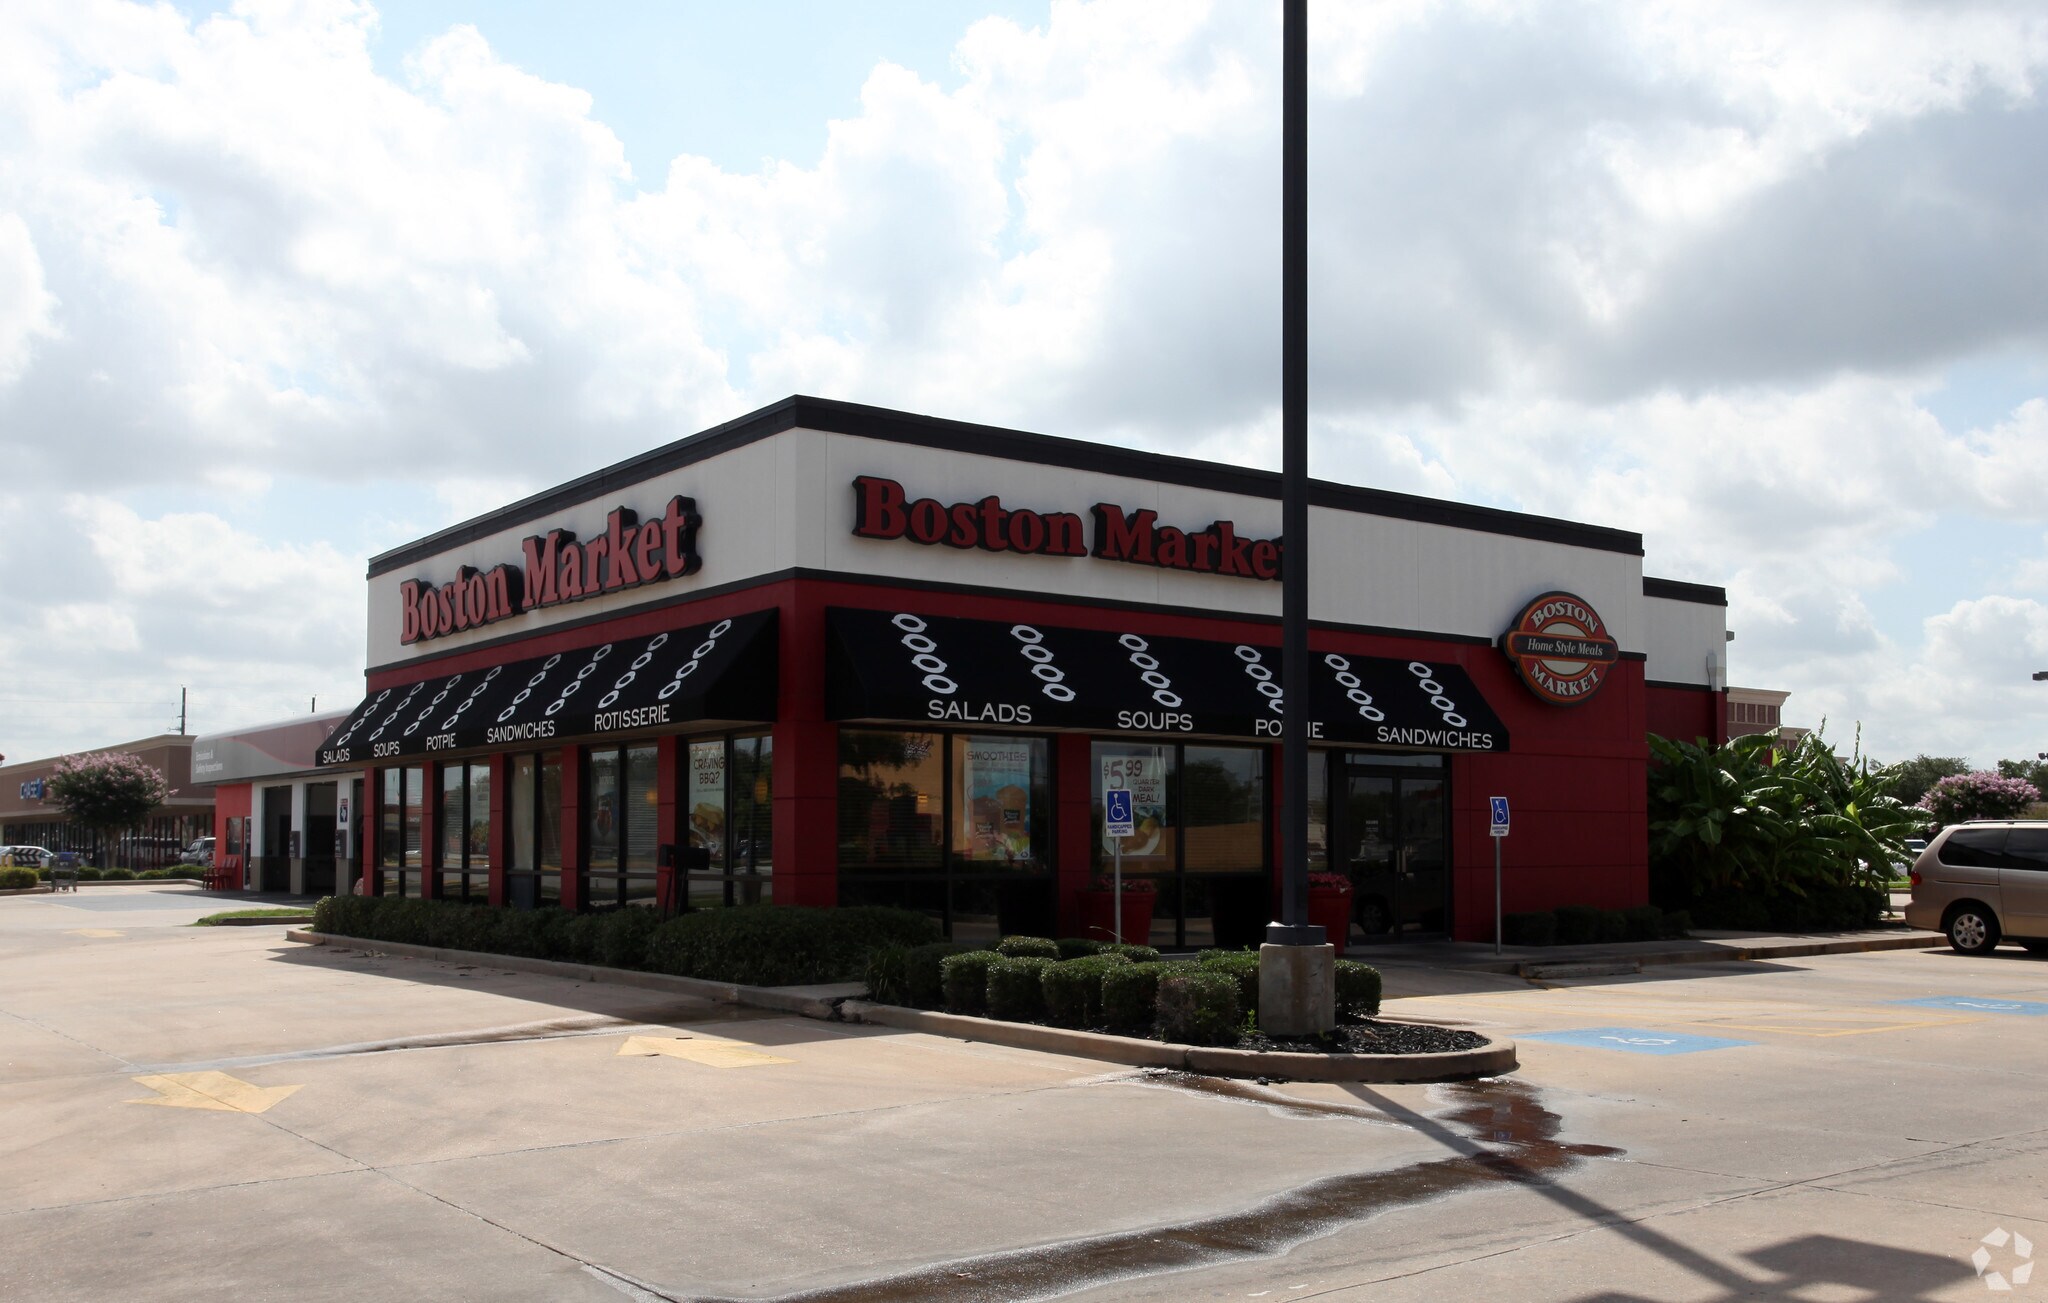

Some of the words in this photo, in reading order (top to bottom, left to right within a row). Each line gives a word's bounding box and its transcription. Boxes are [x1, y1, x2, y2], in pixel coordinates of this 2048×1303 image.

[855, 476, 1087, 557] Boston
[1094, 503, 1283, 580] Marke
[400, 566, 514, 645] Boston
[521, 495, 690, 611] Market
[1531, 601, 1598, 633] BOSTON
[1527, 638, 1554, 652] Home
[1555, 640, 1576, 656] Style
[1577, 642, 1603, 656] Meals
[1531, 662, 1599, 696] MARKET
[322, 747, 351, 764] SALADS
[373, 741, 400, 757] SOUPS
[426, 732, 456, 751] POTPIE
[486, 720, 555, 743] SANDWICHES
[594, 704, 670, 731] ROTISSERIE
[927, 700, 1032, 724] SALADS
[1117, 710, 1193, 732] SOUPS
[1255, 718, 1324, 740] POIE
[1376, 726, 1493, 749] SANDWICHES
[693, 756, 726, 770] CRAVING
[966, 750, 1028, 762] SMOOTHIES
[699, 771, 720, 784] BBQ?
[1132, 794, 1160, 803] MEAL!
